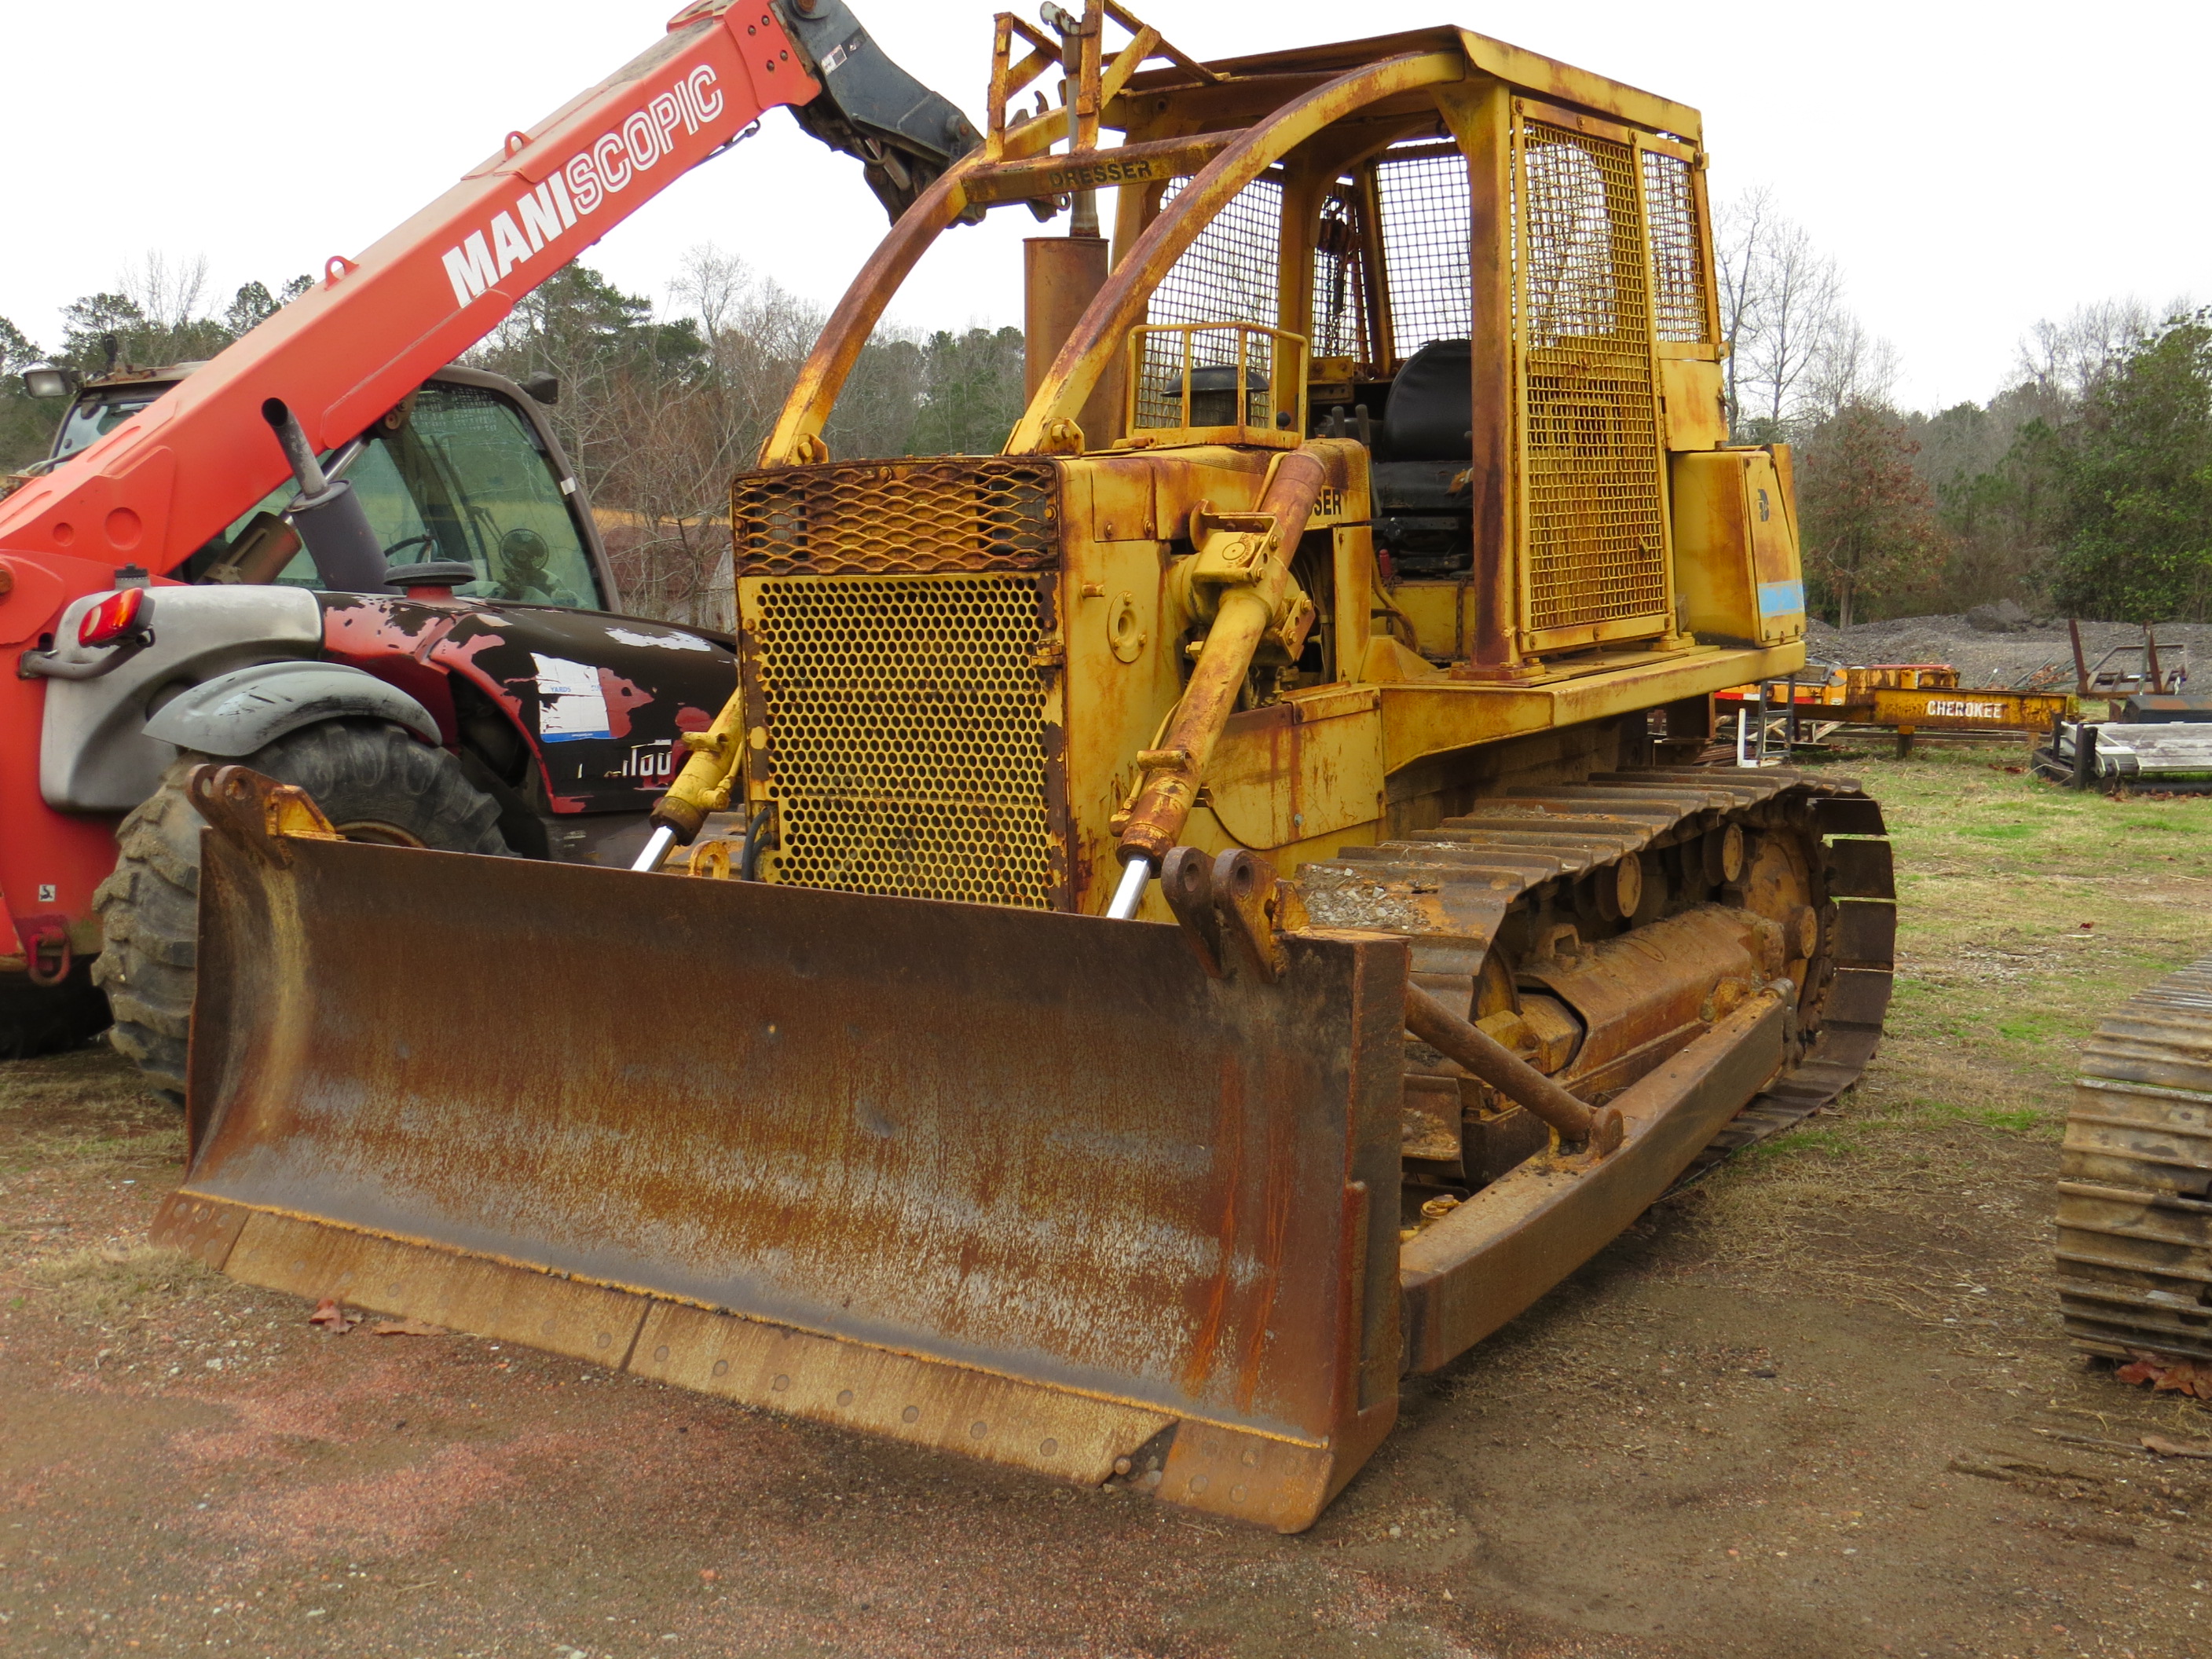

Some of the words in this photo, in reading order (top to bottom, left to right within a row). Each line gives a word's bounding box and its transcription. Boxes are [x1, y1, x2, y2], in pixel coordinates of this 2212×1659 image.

[441, 64, 723, 309] MANISCOPIC
[1049, 160, 1152, 188] DRESSER
[1927, 700, 2002, 718] CHEROKEE
